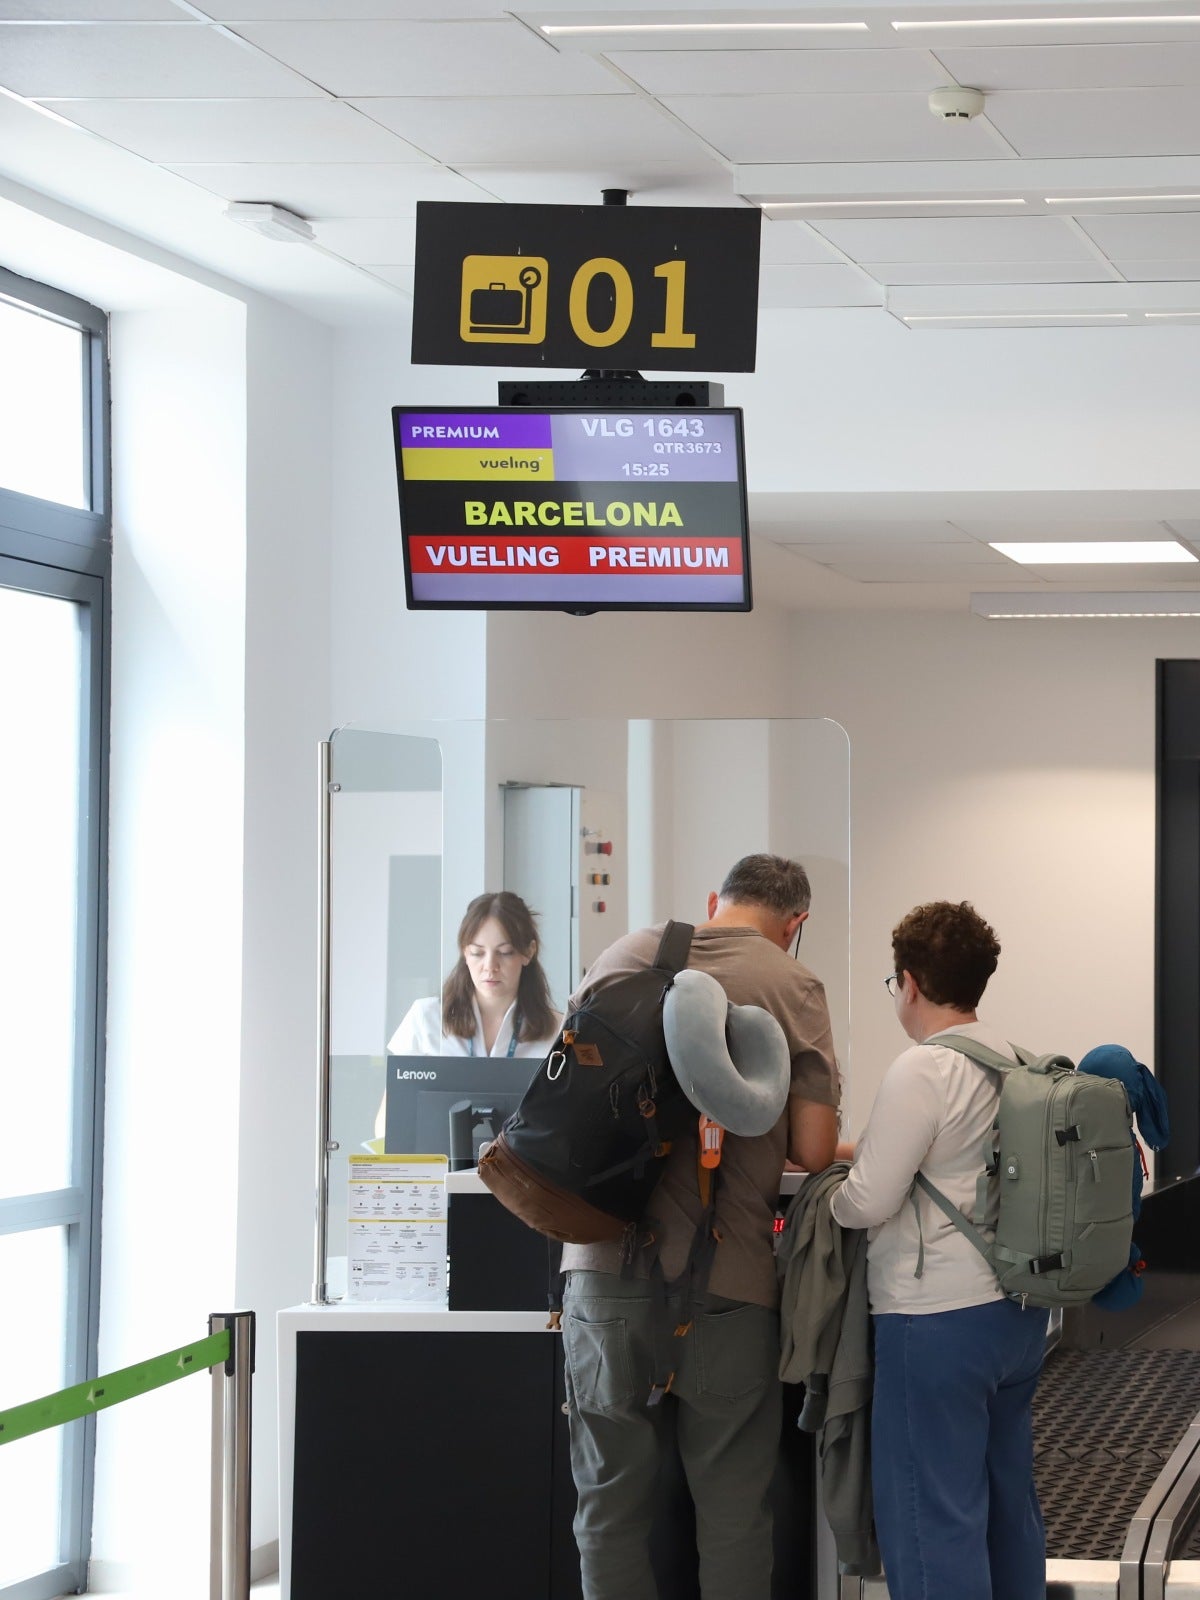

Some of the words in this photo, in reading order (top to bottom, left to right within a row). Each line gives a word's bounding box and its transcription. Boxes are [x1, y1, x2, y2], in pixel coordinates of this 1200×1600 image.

[569, 257, 696, 349] 01
[411, 425, 500, 439] PREMIUM
[581, 418, 634, 437] VLG
[643, 418, 705, 438] 1643
[479, 456, 540, 473] vueling
[621, 463, 670, 477] 15:25
[464, 501, 684, 527] BARCELONA
[425, 545, 560, 567] VUELING
[589, 546, 729, 568] PREMIUM
[396, 1068, 437, 1080] Lenovo
